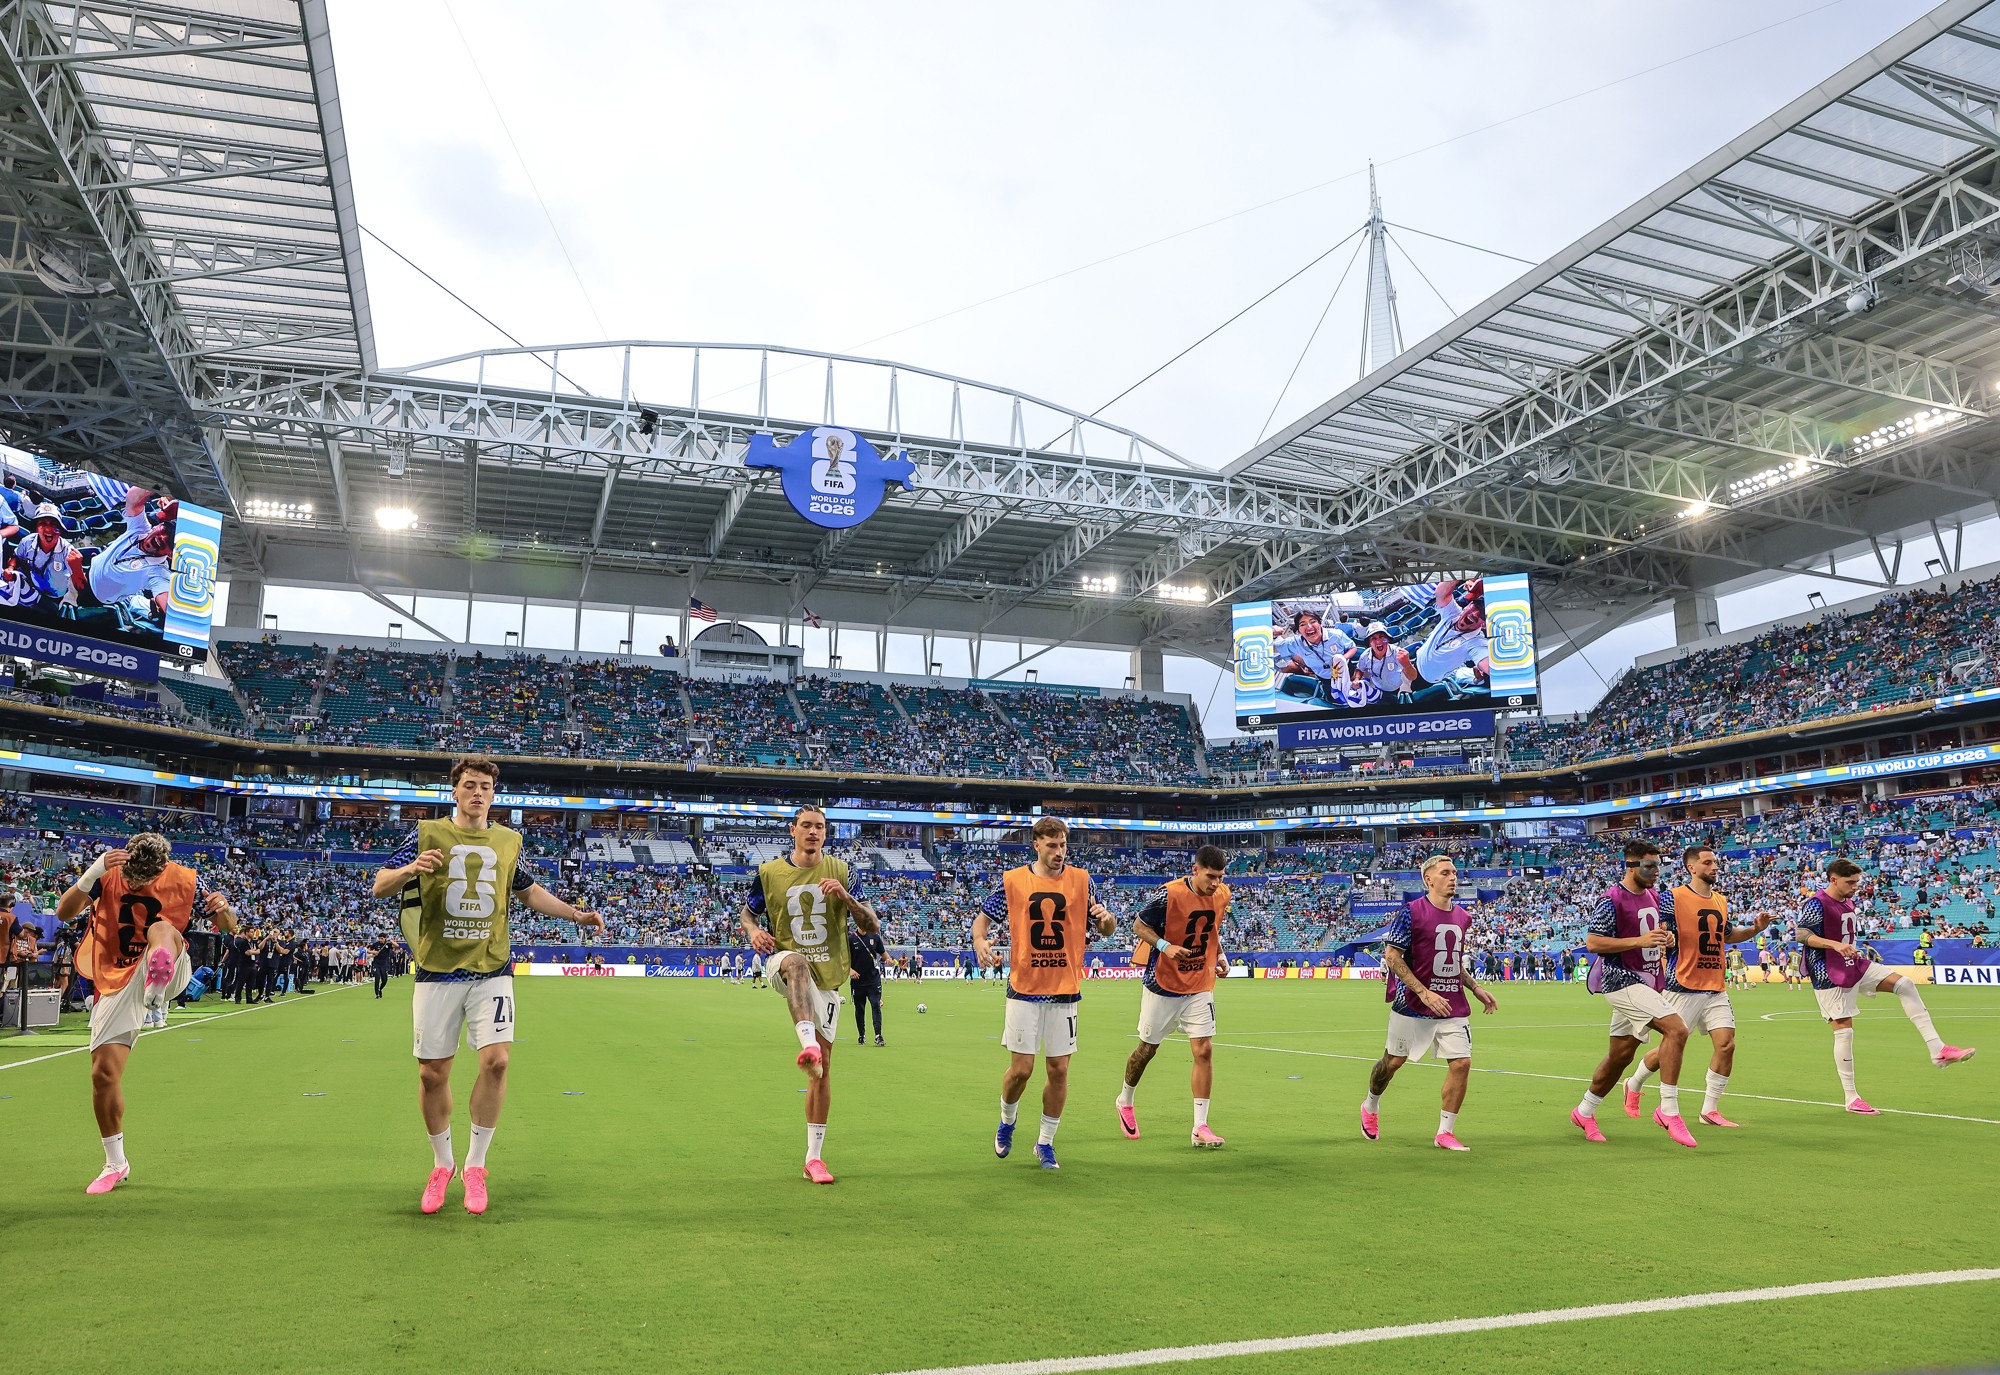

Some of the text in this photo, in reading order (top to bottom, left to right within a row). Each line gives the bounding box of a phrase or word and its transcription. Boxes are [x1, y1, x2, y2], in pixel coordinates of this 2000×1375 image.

[824, 479, 844, 489] FIFA
[810, 494, 856, 505] WORLD CUP
[809, 502, 854, 516] 2026
[35, 638, 74, 656] CUP
[75, 646, 138, 670] 2026
[180, 647, 192, 656] CC
[181, 673, 195, 681] 355
[829, 671, 842, 679] 305
[1509, 697, 1521, 705] CC
[1298, 718, 1472, 741] FIFA WORLD CUP 2026
[1851, 749, 1987, 776] FIFA WORLD CUP 2026
[502, 797, 523, 805] CUP
[524, 798, 560, 806] 2026
[1162, 821, 1254, 831] FIFA WORLD CUP 2026
[729, 836, 756, 844] WORLD
[756, 837, 771, 845] CUP
[459, 902, 482, 912] FIFA
[444, 919, 493, 929] WORLD CUP
[442, 928, 490, 940] 2026
[801, 932, 817, 940] FIFA
[1041, 938, 1057, 946] FIFA
[796, 945, 829, 954] WORLD CUP
[1031, 959, 1067, 968] 2026
[1697, 962, 1722, 970] 202
[647, 964, 695, 977] Michelob
[493, 996, 513, 1023] 21
[827, 1002, 835, 1025] 9
